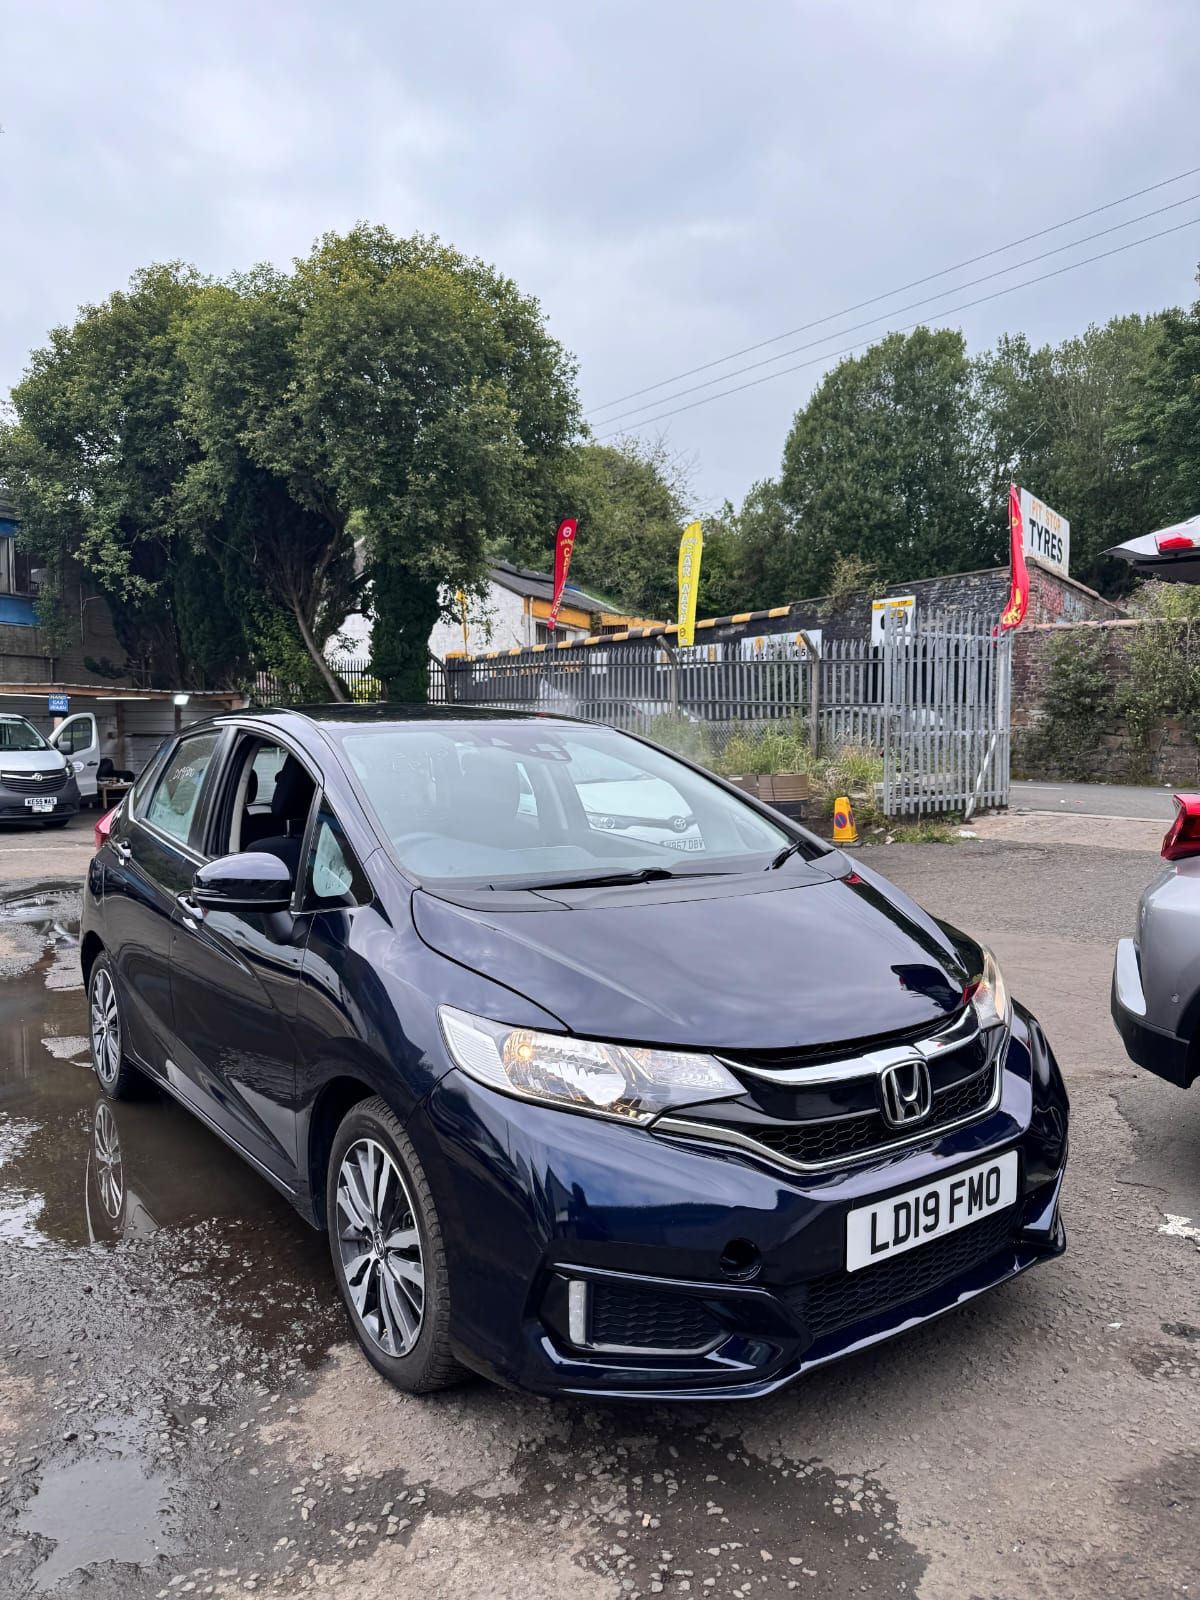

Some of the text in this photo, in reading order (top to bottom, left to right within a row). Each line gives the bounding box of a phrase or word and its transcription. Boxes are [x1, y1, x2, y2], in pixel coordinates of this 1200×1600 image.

[1031, 499, 1062, 532] PIT STOP
[1029, 518, 1063, 564] TYRES
[871, 1166, 1001, 1255] LD19 FMO
